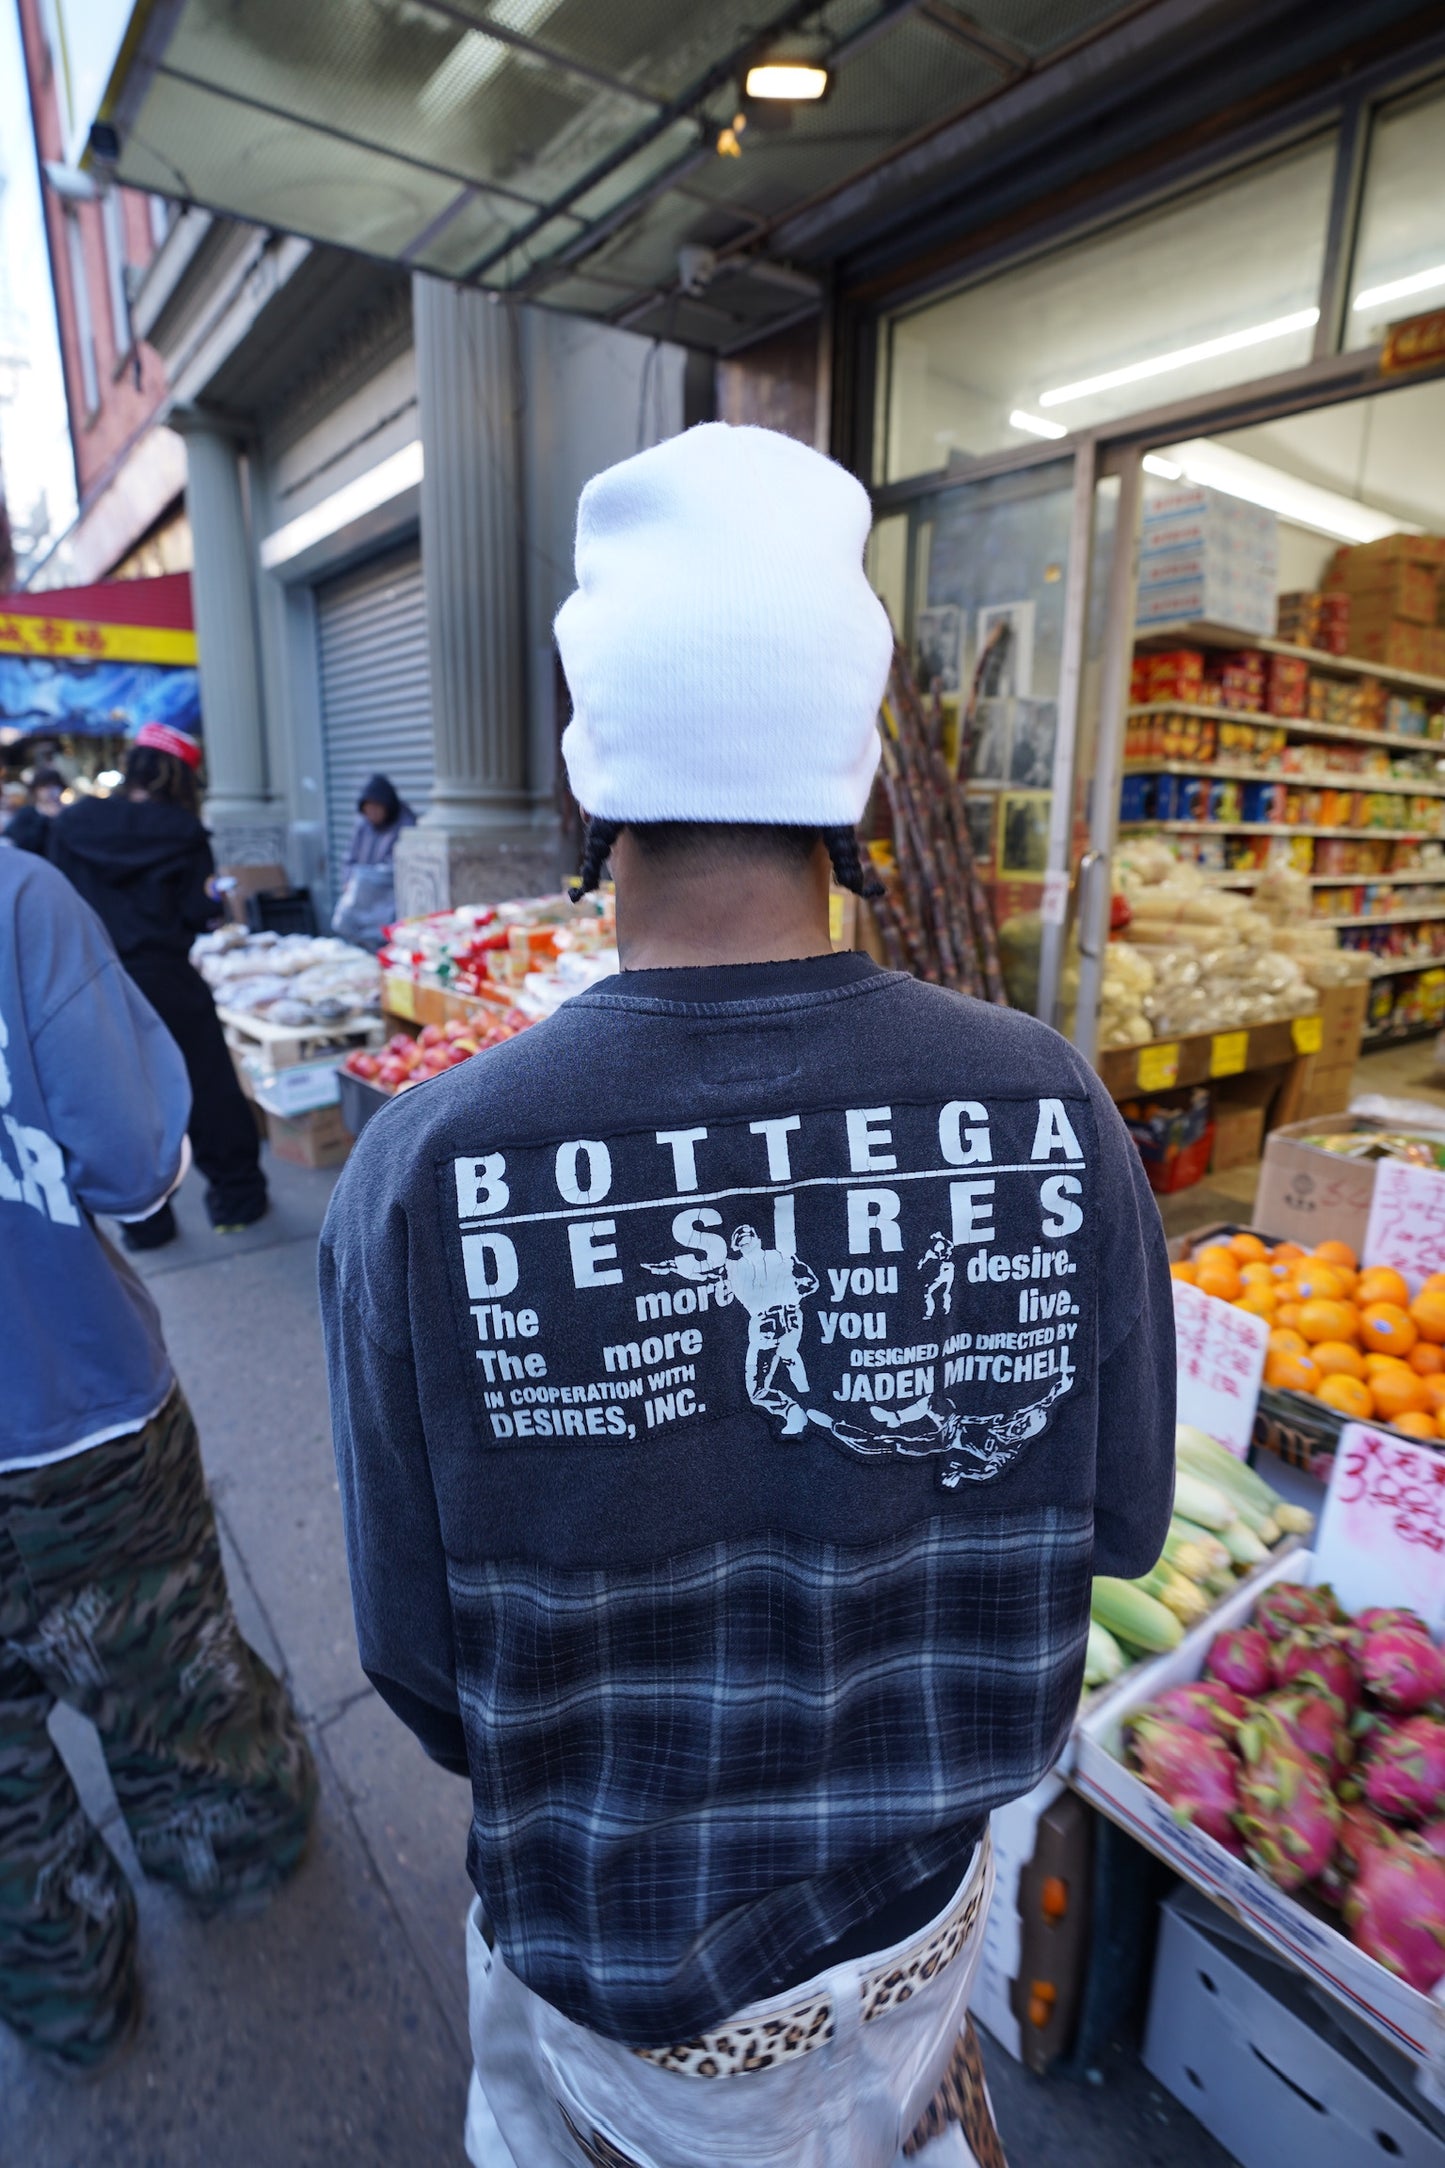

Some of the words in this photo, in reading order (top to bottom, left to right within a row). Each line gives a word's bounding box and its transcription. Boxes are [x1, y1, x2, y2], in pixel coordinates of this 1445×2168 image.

[455, 1099, 1084, 1218] BOTTEGA
[462, 1175, 1084, 1299] DESIRES
[470, 1304, 540, 1340] The
[636, 1279, 735, 1322] more
[828, 1267, 898, 1303] you
[967, 1246, 1077, 1284] desire.
[476, 1350, 548, 1382] The
[603, 1328, 703, 1373] more
[818, 1311, 887, 1344] you
[1019, 1288, 1080, 1324] live.
[851, 1344, 938, 1367] DESIGNED
[942, 1333, 972, 1357] AND
[976, 1327, 1055, 1351] DIRECTED
[1057, 1323, 1078, 1341] BY
[484, 1391, 505, 1409] IN
[510, 1377, 644, 1405] COOPERATION
[648, 1364, 696, 1392] WITH
[833, 1366, 935, 1403] JADEN
[944, 1346, 1076, 1389] MITCHELL
[490, 1406, 636, 1440] DESIRES,
[645, 1388, 706, 1429] INC.
